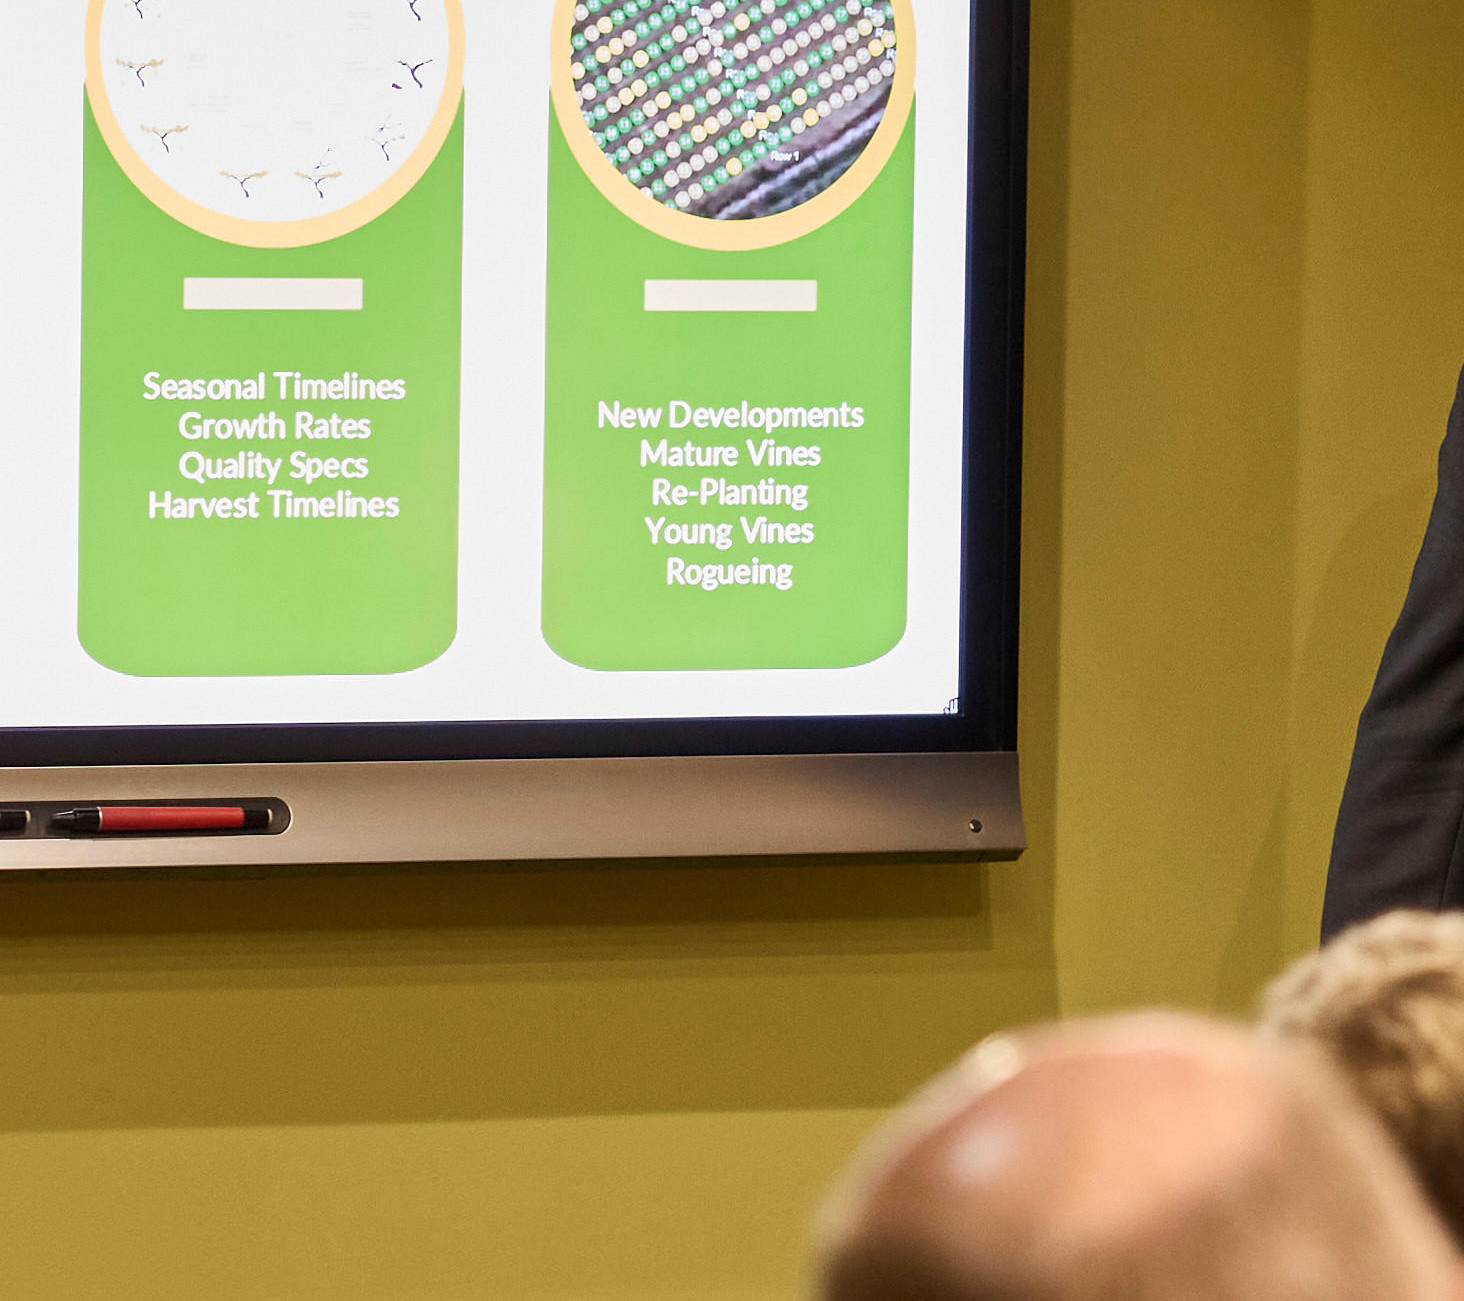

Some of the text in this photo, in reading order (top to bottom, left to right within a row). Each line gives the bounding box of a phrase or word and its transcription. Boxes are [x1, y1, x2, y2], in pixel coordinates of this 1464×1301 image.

[143, 372, 406, 400] Seasonal Timelines
[179, 411, 371, 439] Growth Rates
[598, 400, 864, 434] New Developments
[179, 451, 368, 484] Quality Specs
[640, 439, 821, 466] Mature Vines
[149, 490, 400, 518] Harvest Timelines
[653, 478, 808, 510] Re-Planting
[644, 516, 814, 550] Young Vines
[667, 557, 793, 590] Rogueing
